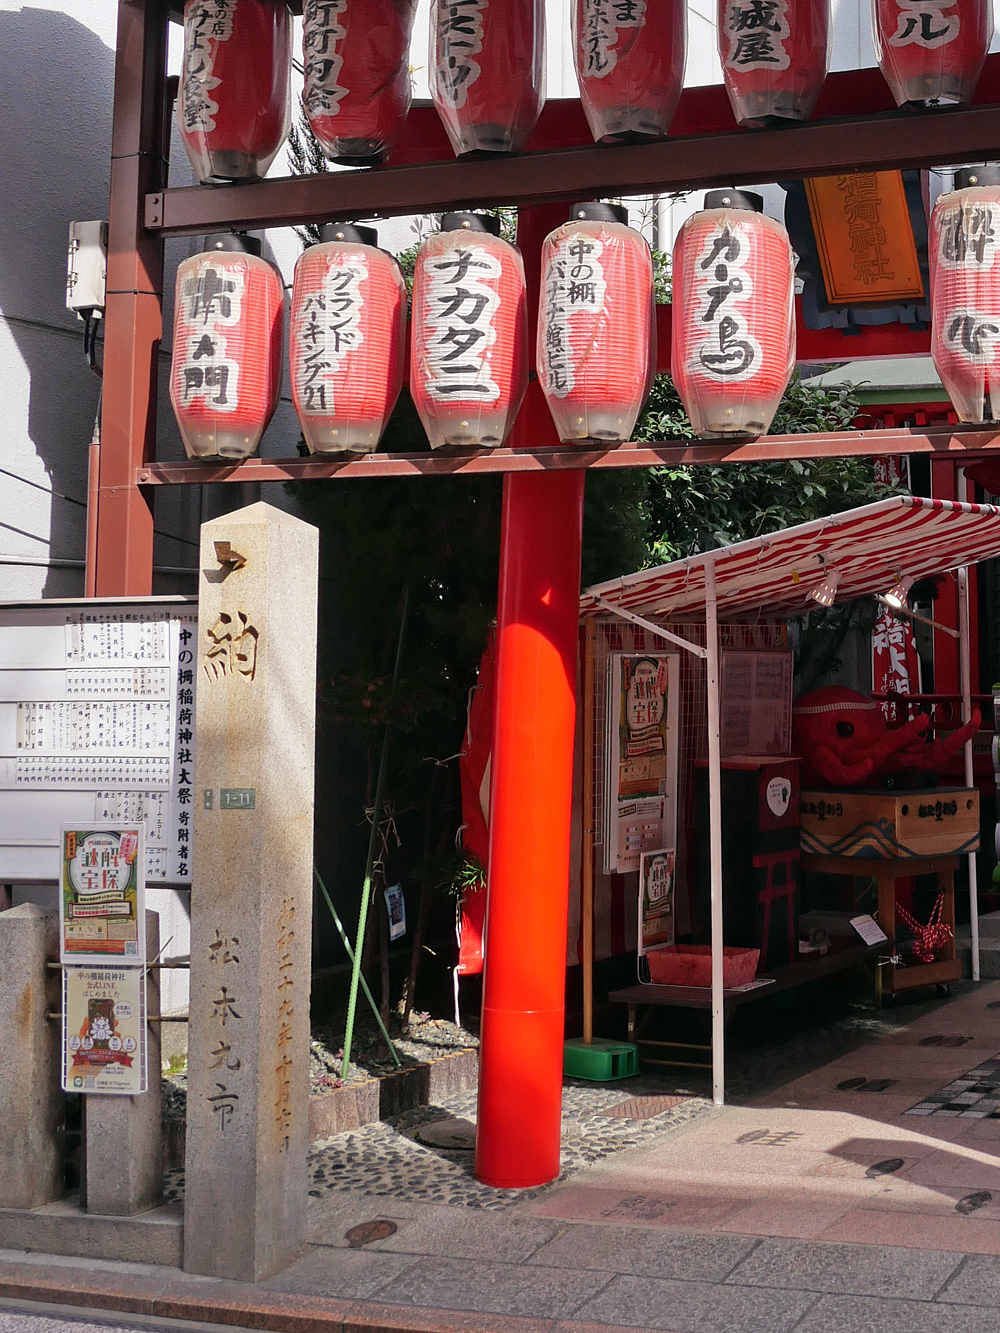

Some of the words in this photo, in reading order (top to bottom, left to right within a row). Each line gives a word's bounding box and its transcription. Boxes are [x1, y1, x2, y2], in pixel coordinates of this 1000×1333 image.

[837, 170, 895, 286] 稲荷神社
[566, 239, 597, 305] 中の棚
[700, 226, 756, 376] カープ鳥
[330, 266, 361, 353] グランド
[433, 248, 493, 395] ナカタニ
[545, 259, 568, 392] バナナ館ビル
[302, 294, 332, 411] パーキング21
[203, 610, 260, 683] 納
[225, 793, 250, 804] 1-11
[176, 810, 191, 877] 寄附者名
[77, 971, 126, 981] 中の棚稲荷神社
[82, 990, 120, 998] はじめました
[86, 981, 116, 989] 公式LINE
